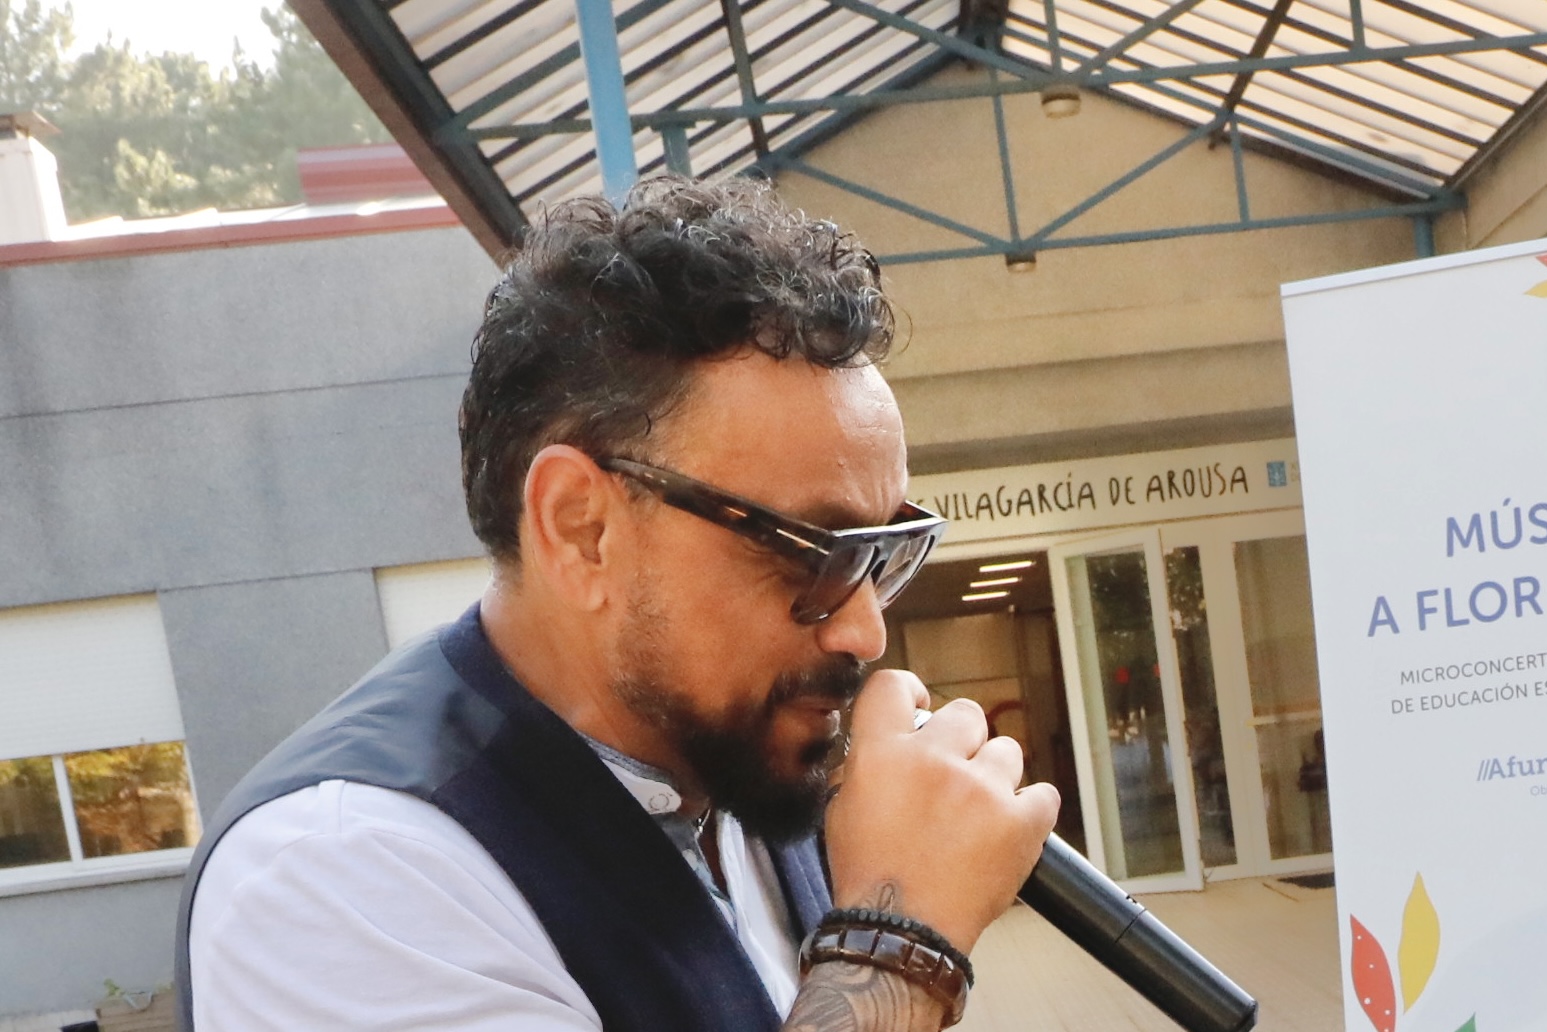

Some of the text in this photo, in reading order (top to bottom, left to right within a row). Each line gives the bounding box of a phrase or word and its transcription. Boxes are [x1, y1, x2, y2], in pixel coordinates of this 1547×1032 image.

[934, 473, 1097, 522] VILAGARCÍA
[1109, 476, 1137, 507] DE
[1146, 463, 1250, 503] AROUSA
[1367, 596, 1401, 638] A
[1416, 575, 1544, 632] FLOR
[1391, 698, 1415, 715] DE
[1420, 682, 1528, 712] EDUCACIÓN
